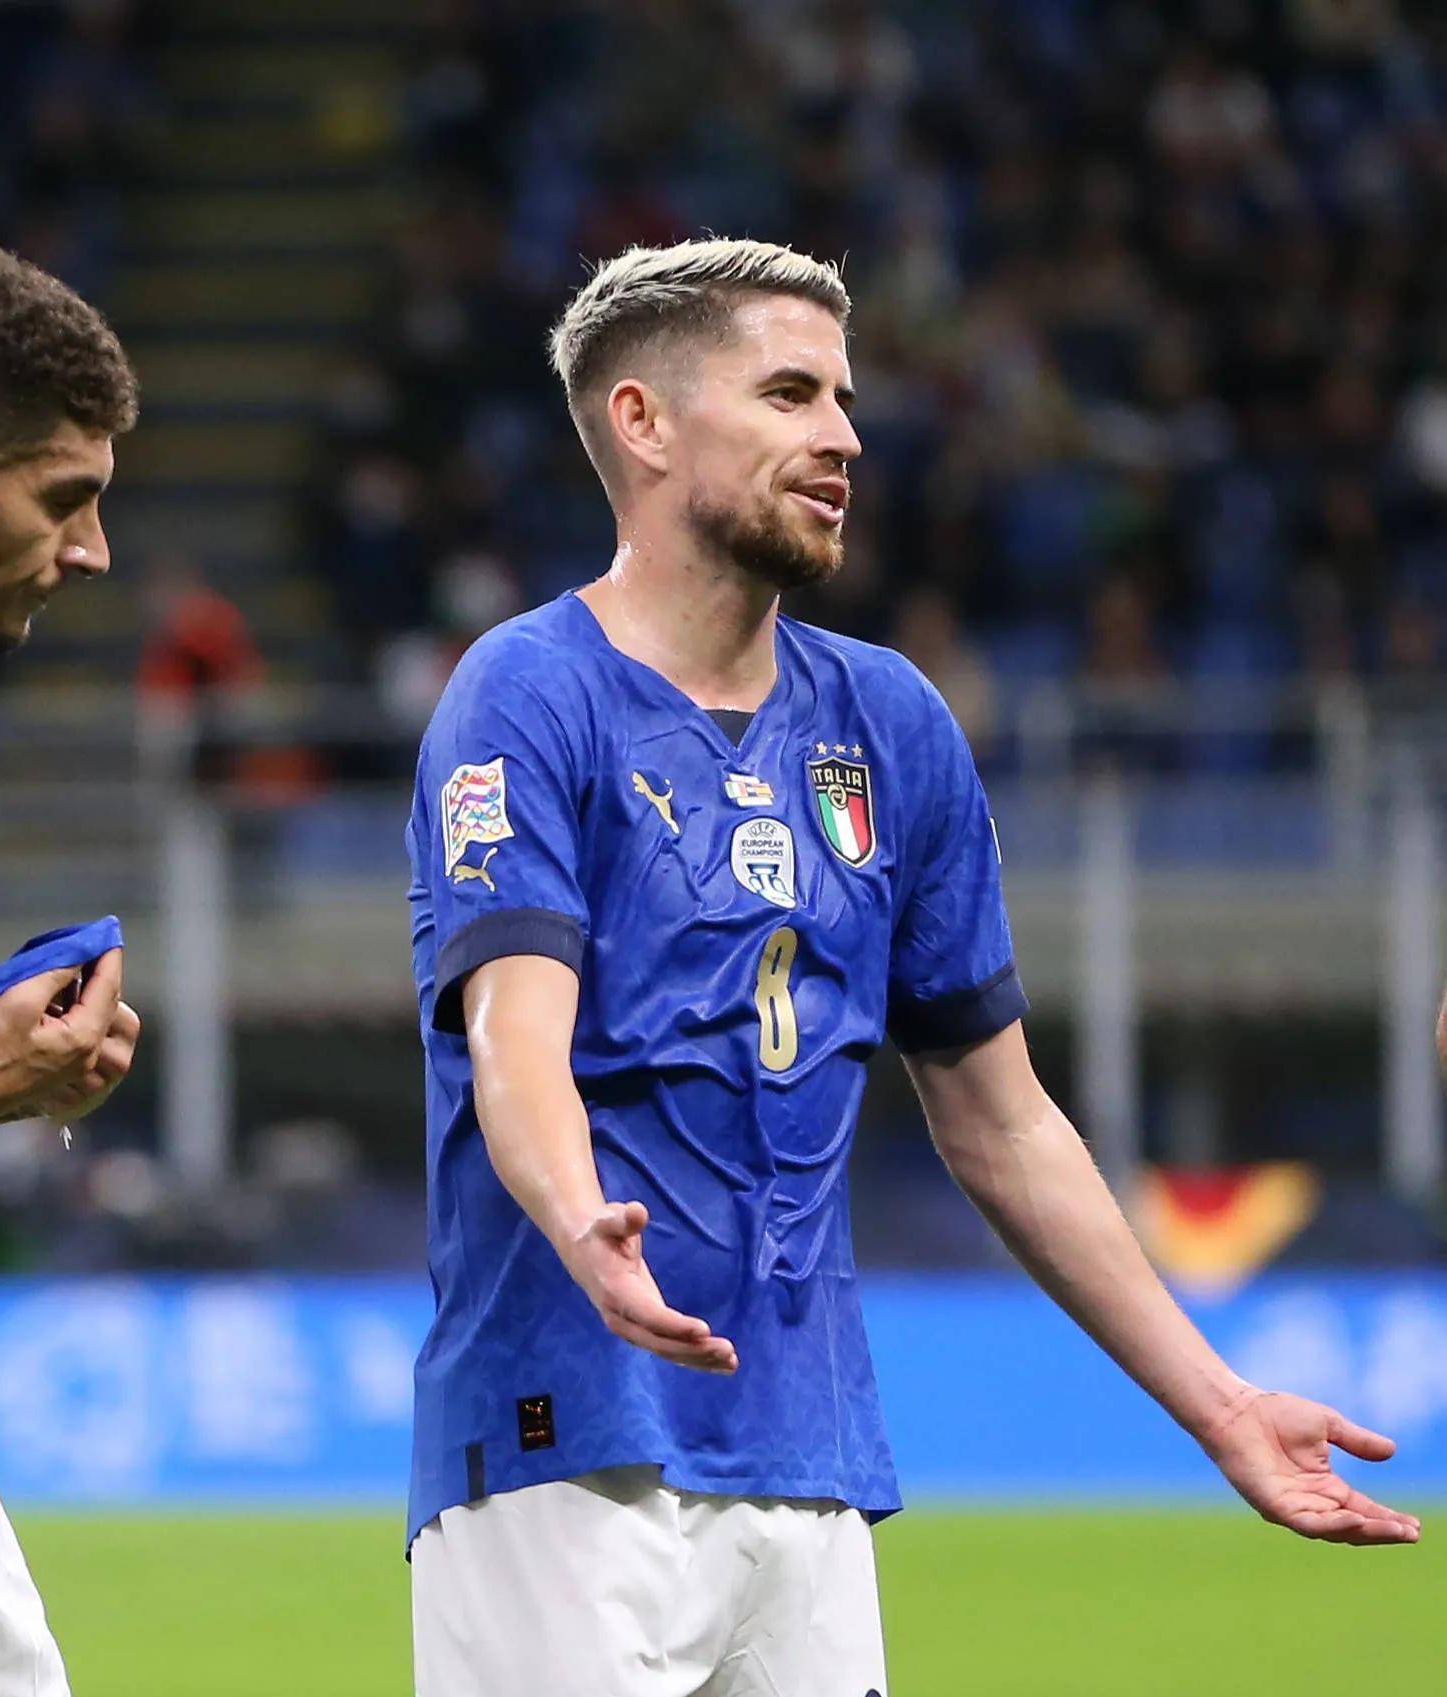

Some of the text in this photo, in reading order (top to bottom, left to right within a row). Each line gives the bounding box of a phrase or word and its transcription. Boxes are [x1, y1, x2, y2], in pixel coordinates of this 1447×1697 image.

[811, 767, 863, 787] ITALIA
[741, 839, 785, 848] EUROPEAN
[741, 849, 784, 857] CHAMPIONS
[754, 927, 798, 1073] 8
